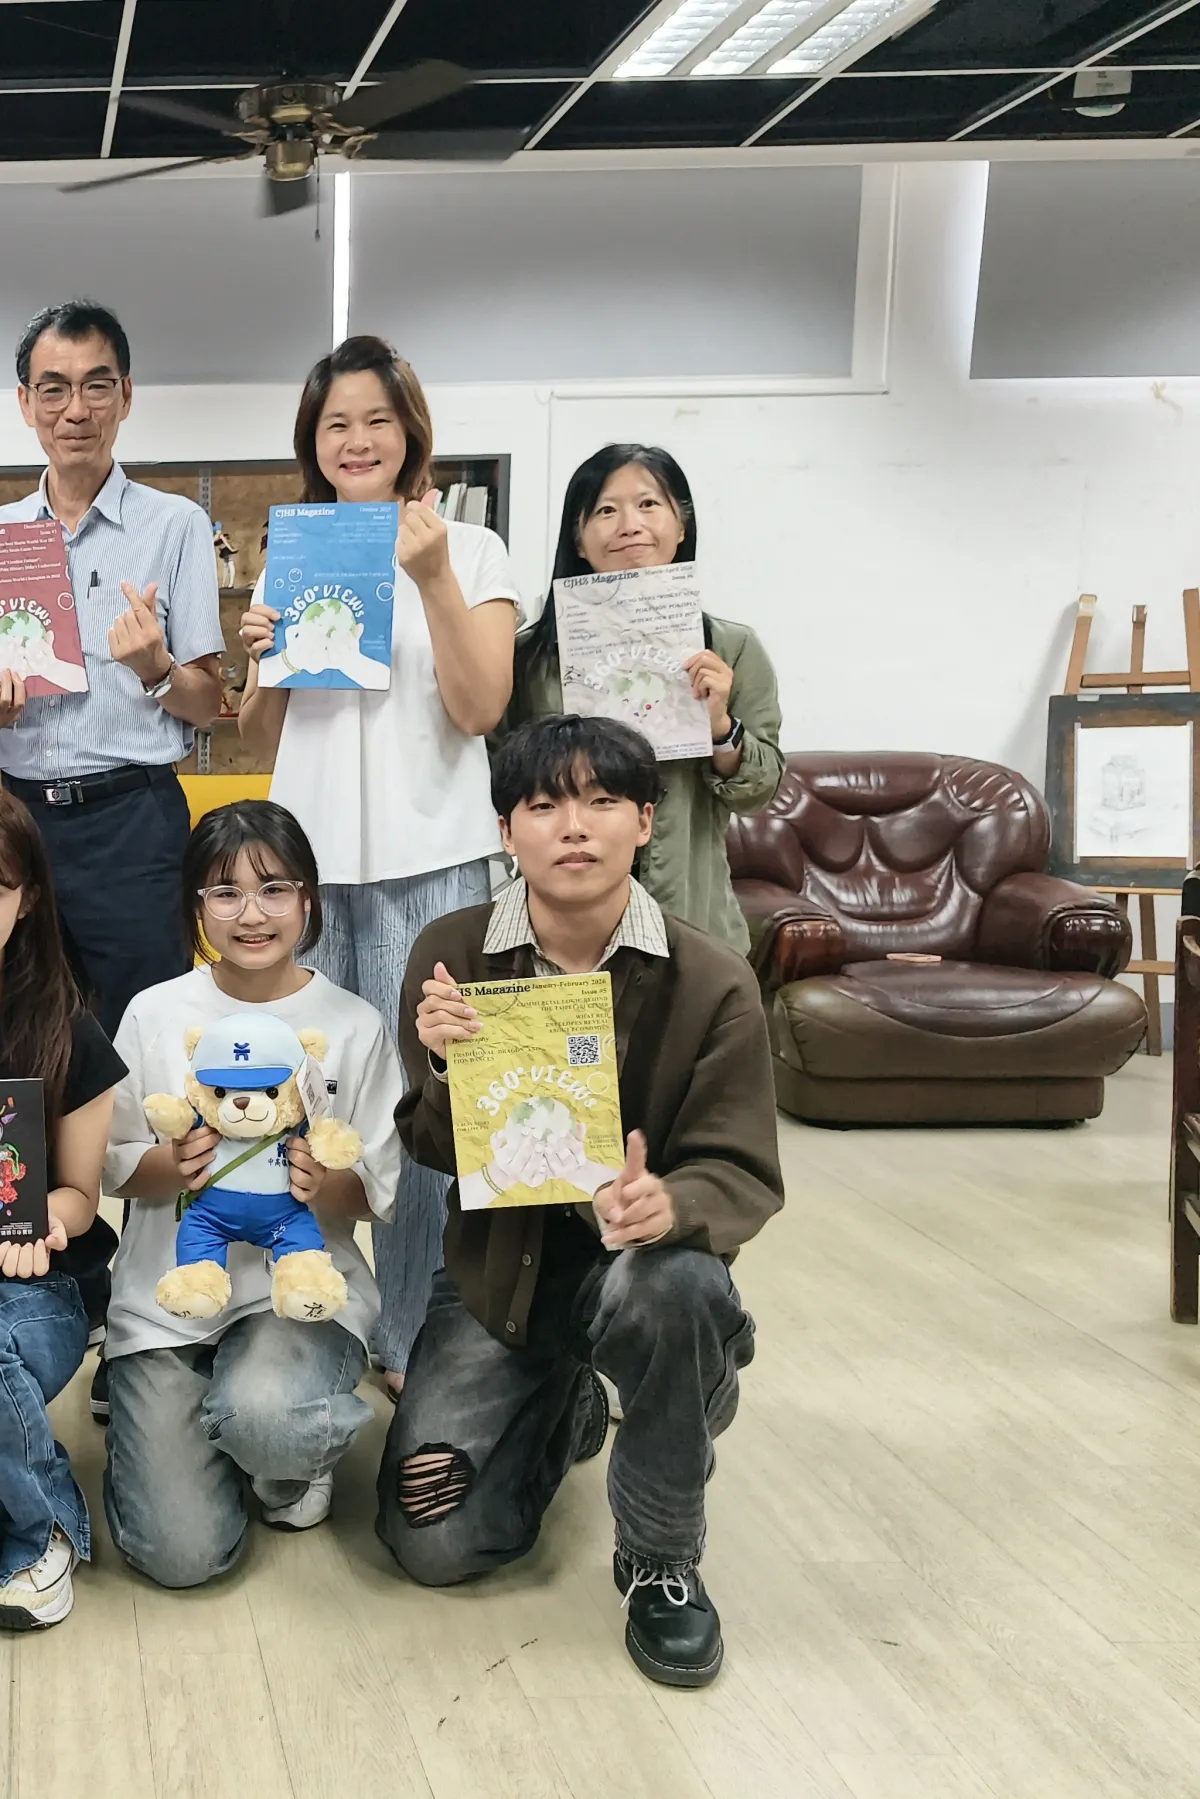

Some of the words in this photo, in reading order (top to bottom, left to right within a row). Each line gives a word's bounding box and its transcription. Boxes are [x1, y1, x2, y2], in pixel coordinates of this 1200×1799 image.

[297, 507, 336, 517] Magazine
[591, 571, 640, 585] Magazine
[457, 987, 472, 996] HS
[474, 984, 530, 996] Magazine
[532, 981, 588, 990] January-February
[452, 1036, 489, 1044] Photography
[476, 1066, 524, 1116] 360°
